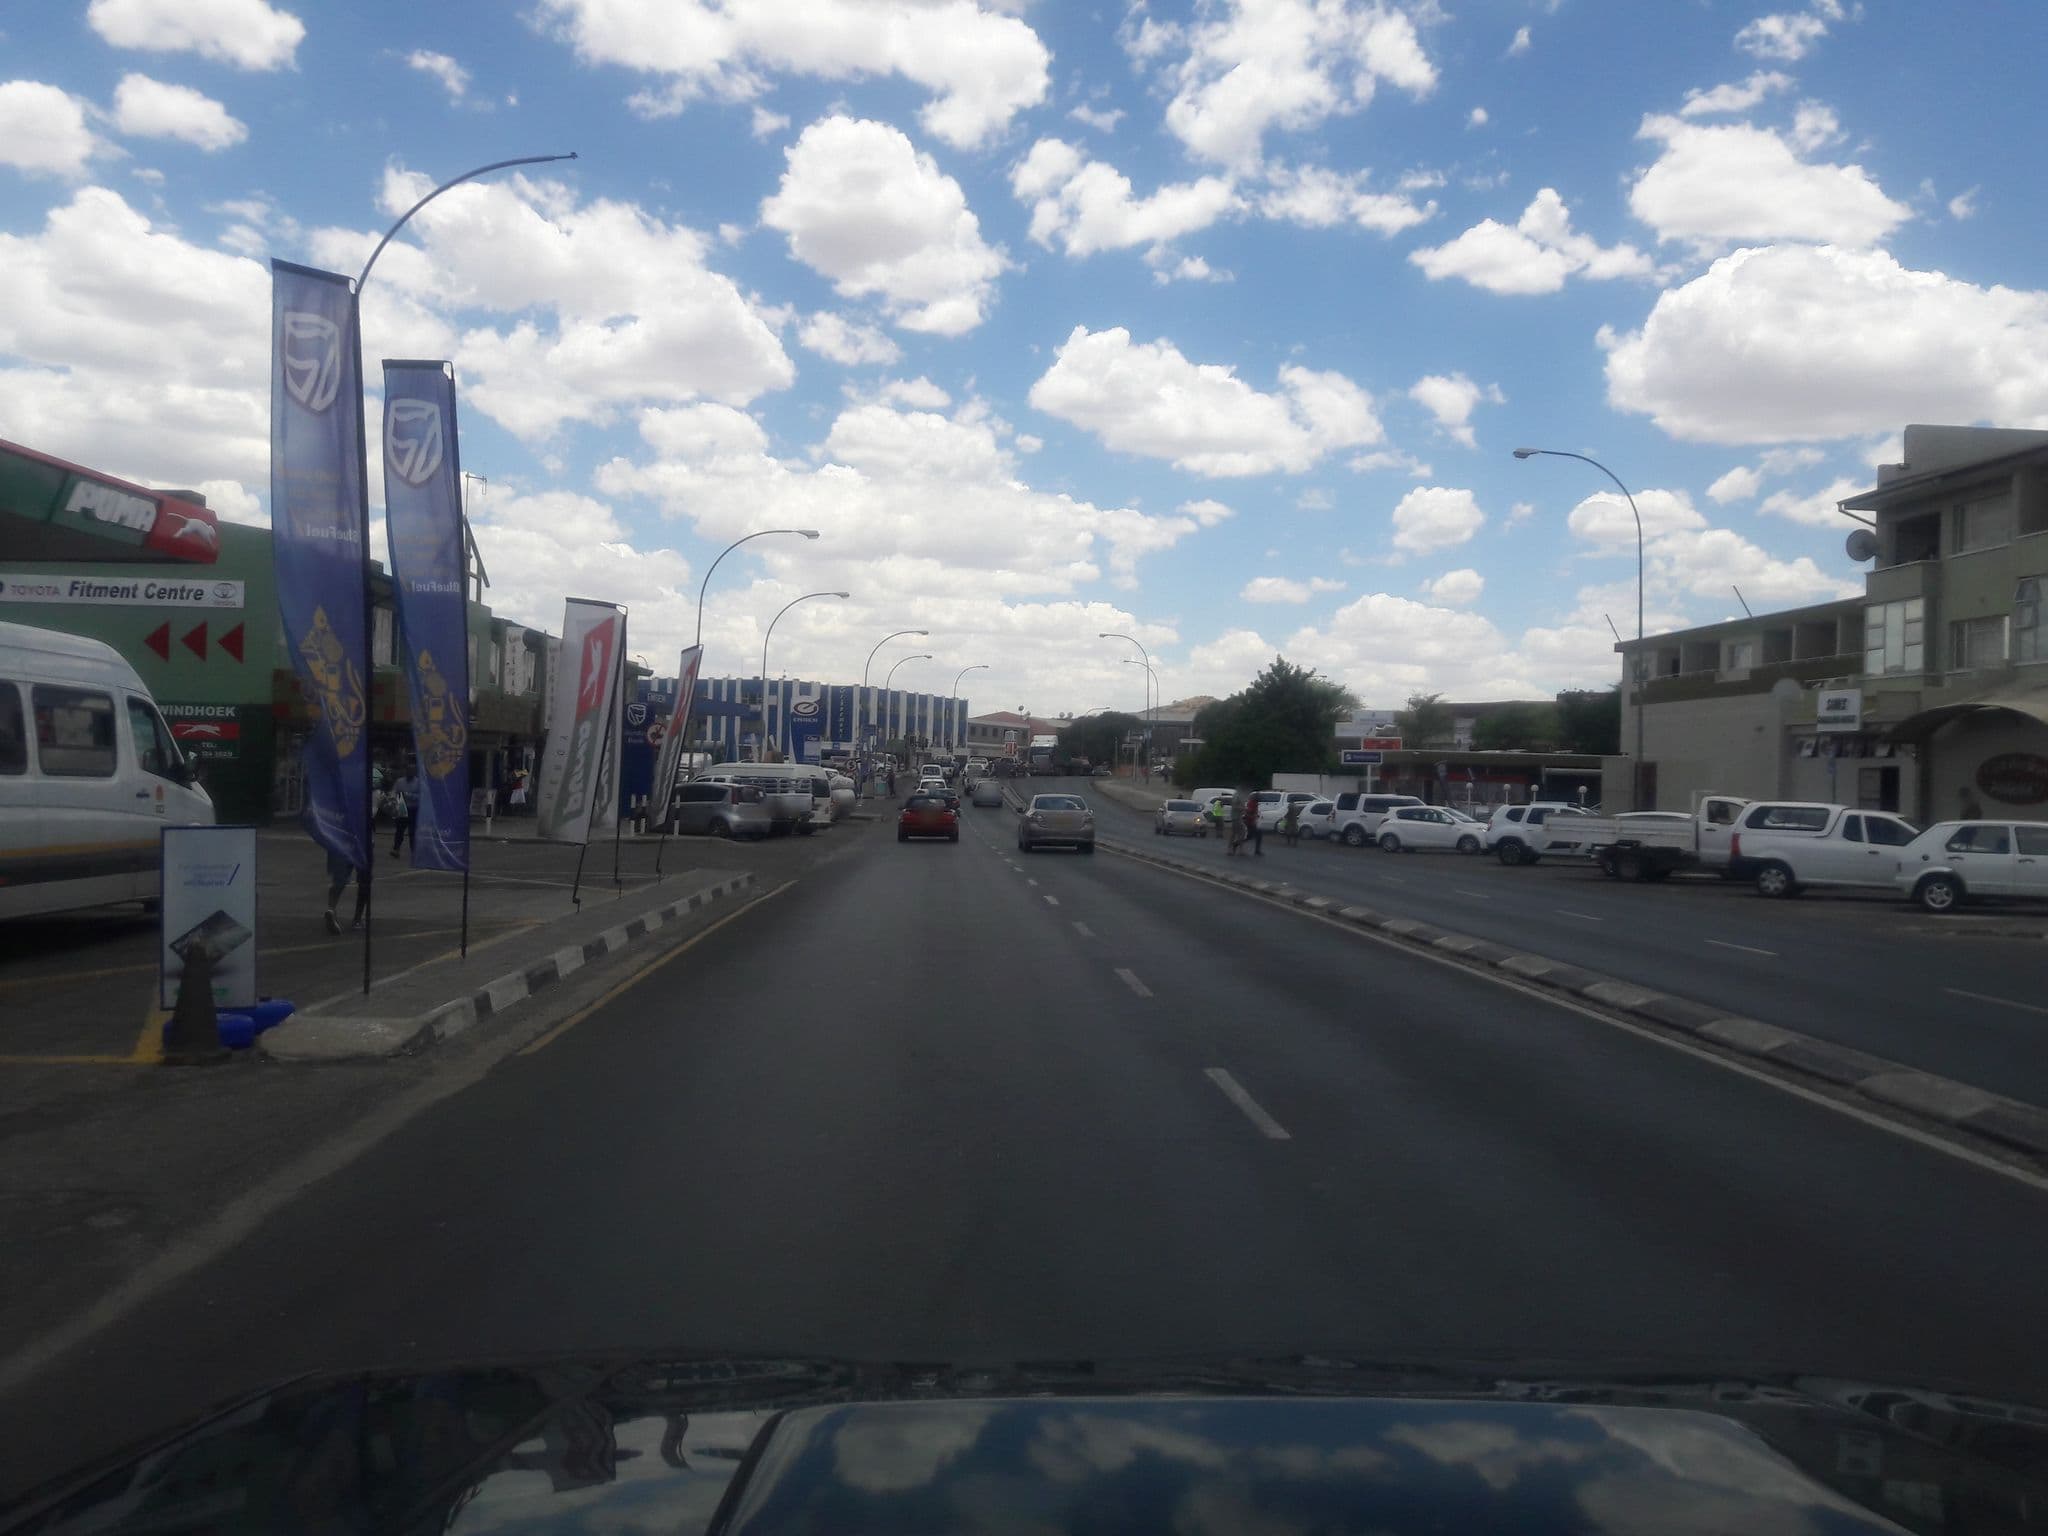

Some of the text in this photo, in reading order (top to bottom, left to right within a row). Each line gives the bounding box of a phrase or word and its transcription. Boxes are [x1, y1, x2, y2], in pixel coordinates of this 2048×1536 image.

[11, 585, 61, 596] TOYOTA
[68, 580, 137, 599] Fitment
[143, 583, 204, 601] Centre
[159, 705, 236, 717] WINDHOEK
